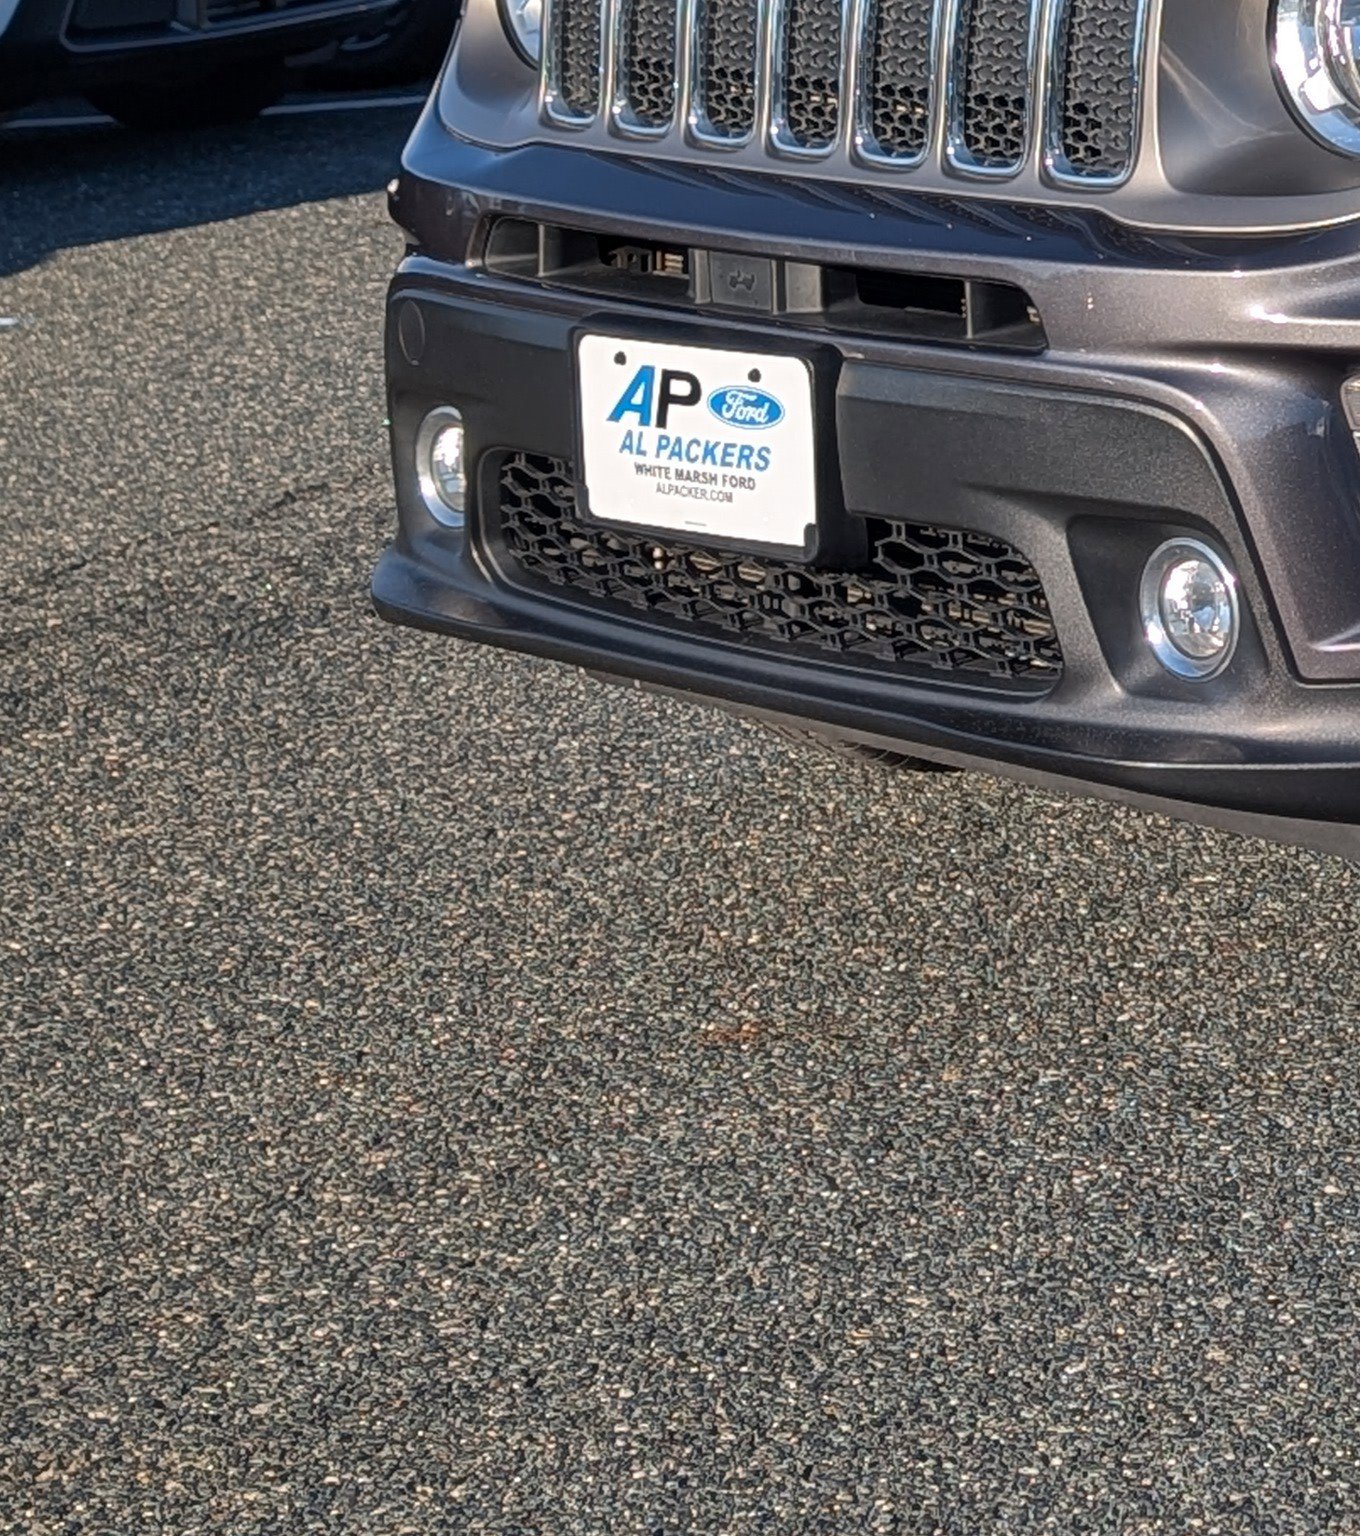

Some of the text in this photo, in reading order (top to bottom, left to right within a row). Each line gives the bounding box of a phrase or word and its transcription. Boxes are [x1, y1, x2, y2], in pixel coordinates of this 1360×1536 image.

[606, 364, 771, 429] AP Ford
[619, 430, 771, 472] AL PACKERS
[634, 462, 756, 490] WHITE MARSH FORD
[656, 482, 733, 503] ALPACKER.COM
